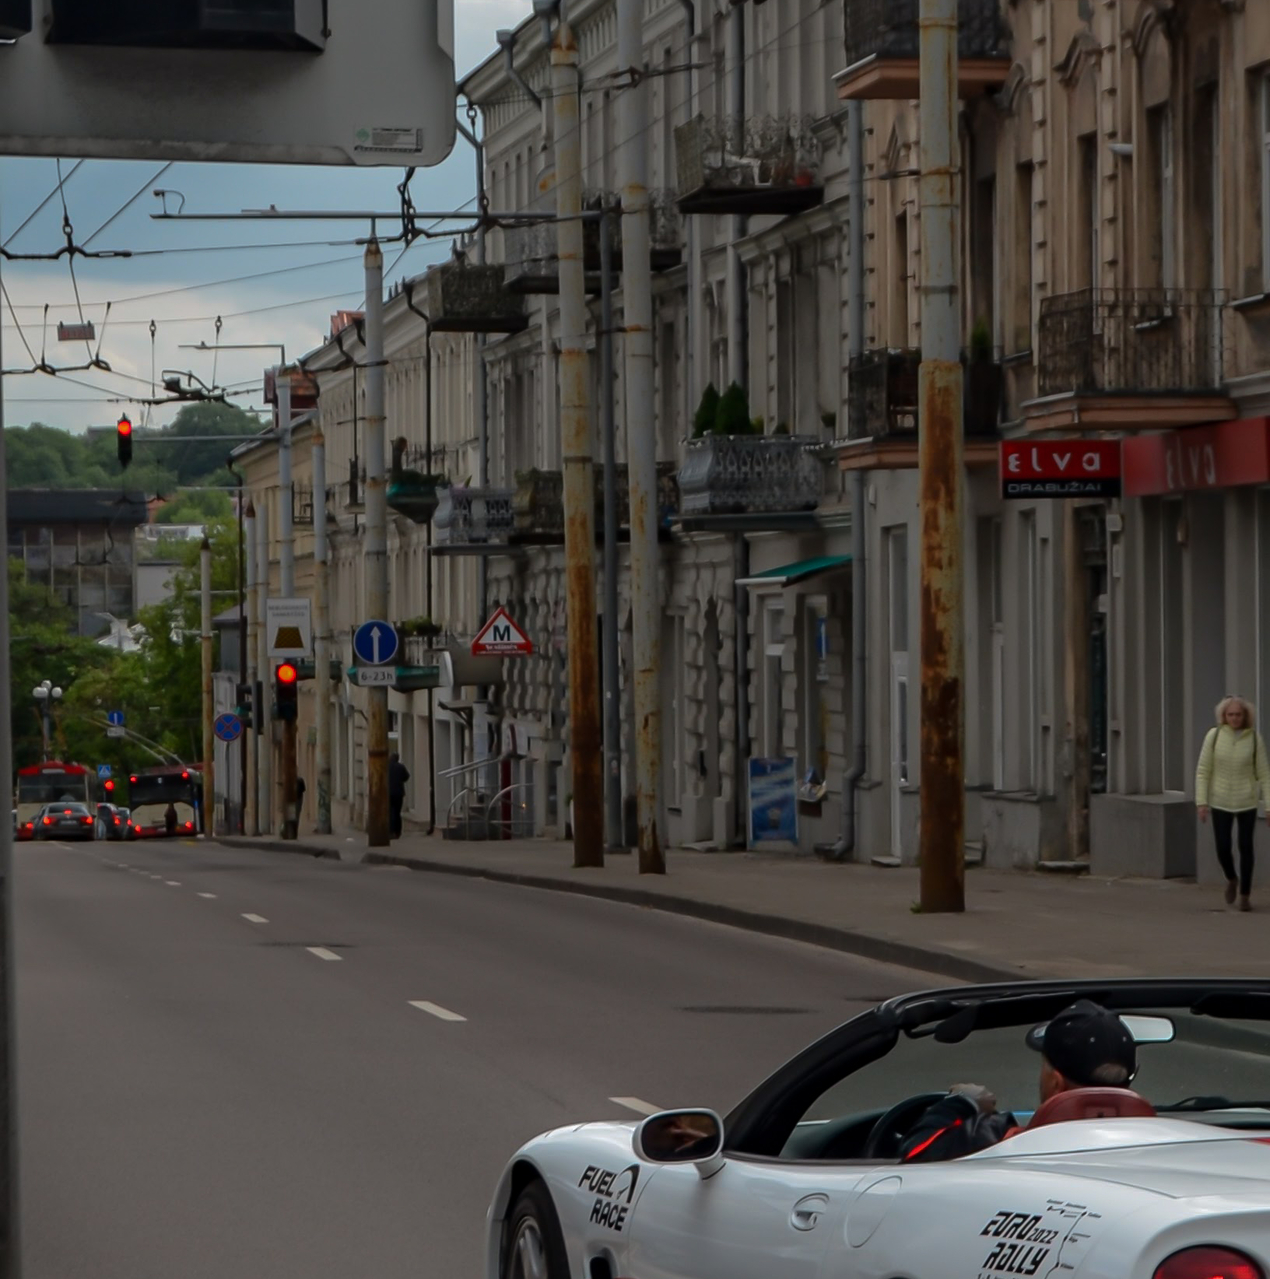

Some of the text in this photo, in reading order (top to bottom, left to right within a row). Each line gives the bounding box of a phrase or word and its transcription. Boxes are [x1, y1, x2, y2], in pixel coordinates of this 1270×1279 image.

[1007, 479, 1101, 494] DRABUŽIAI
[493, 625, 511, 641] M
[361, 672, 393, 682] 6-23h
[578, 1165, 618, 1198] FUEL
[590, 1197, 629, 1231] RACE
[1026, 1228, 1059, 1244] 2022
